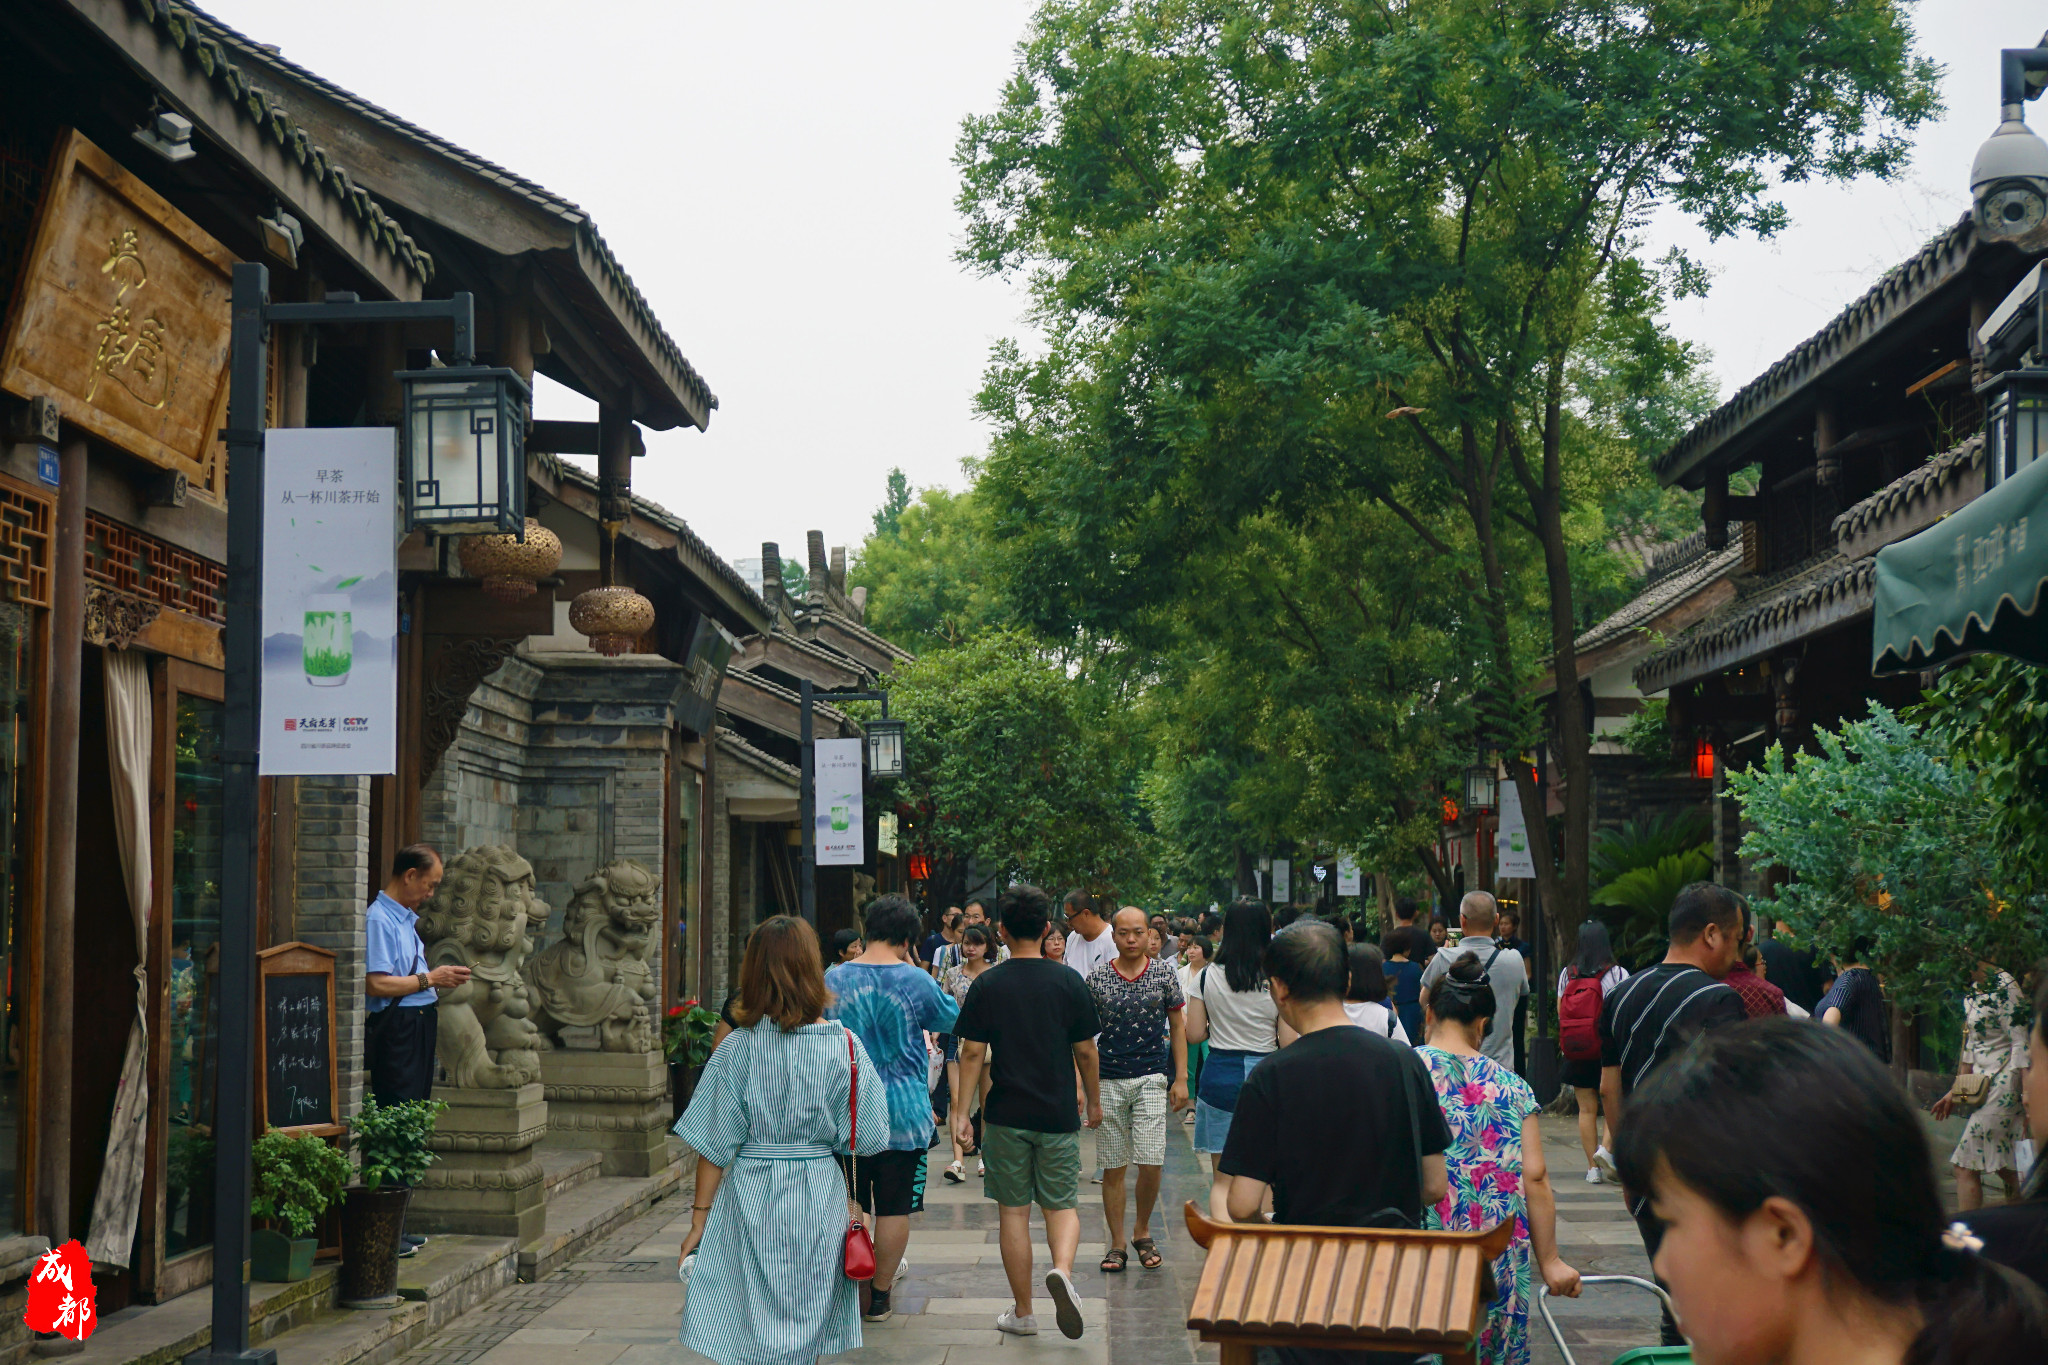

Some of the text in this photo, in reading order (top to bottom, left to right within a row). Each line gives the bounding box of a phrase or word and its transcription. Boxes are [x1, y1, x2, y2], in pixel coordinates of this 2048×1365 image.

[315, 469, 344, 484] 早茶
[281, 490, 380, 504] 从一杯川茶开始
[299, 717, 337, 729] 天府龙芽
[343, 717, 369, 726] CCTV
